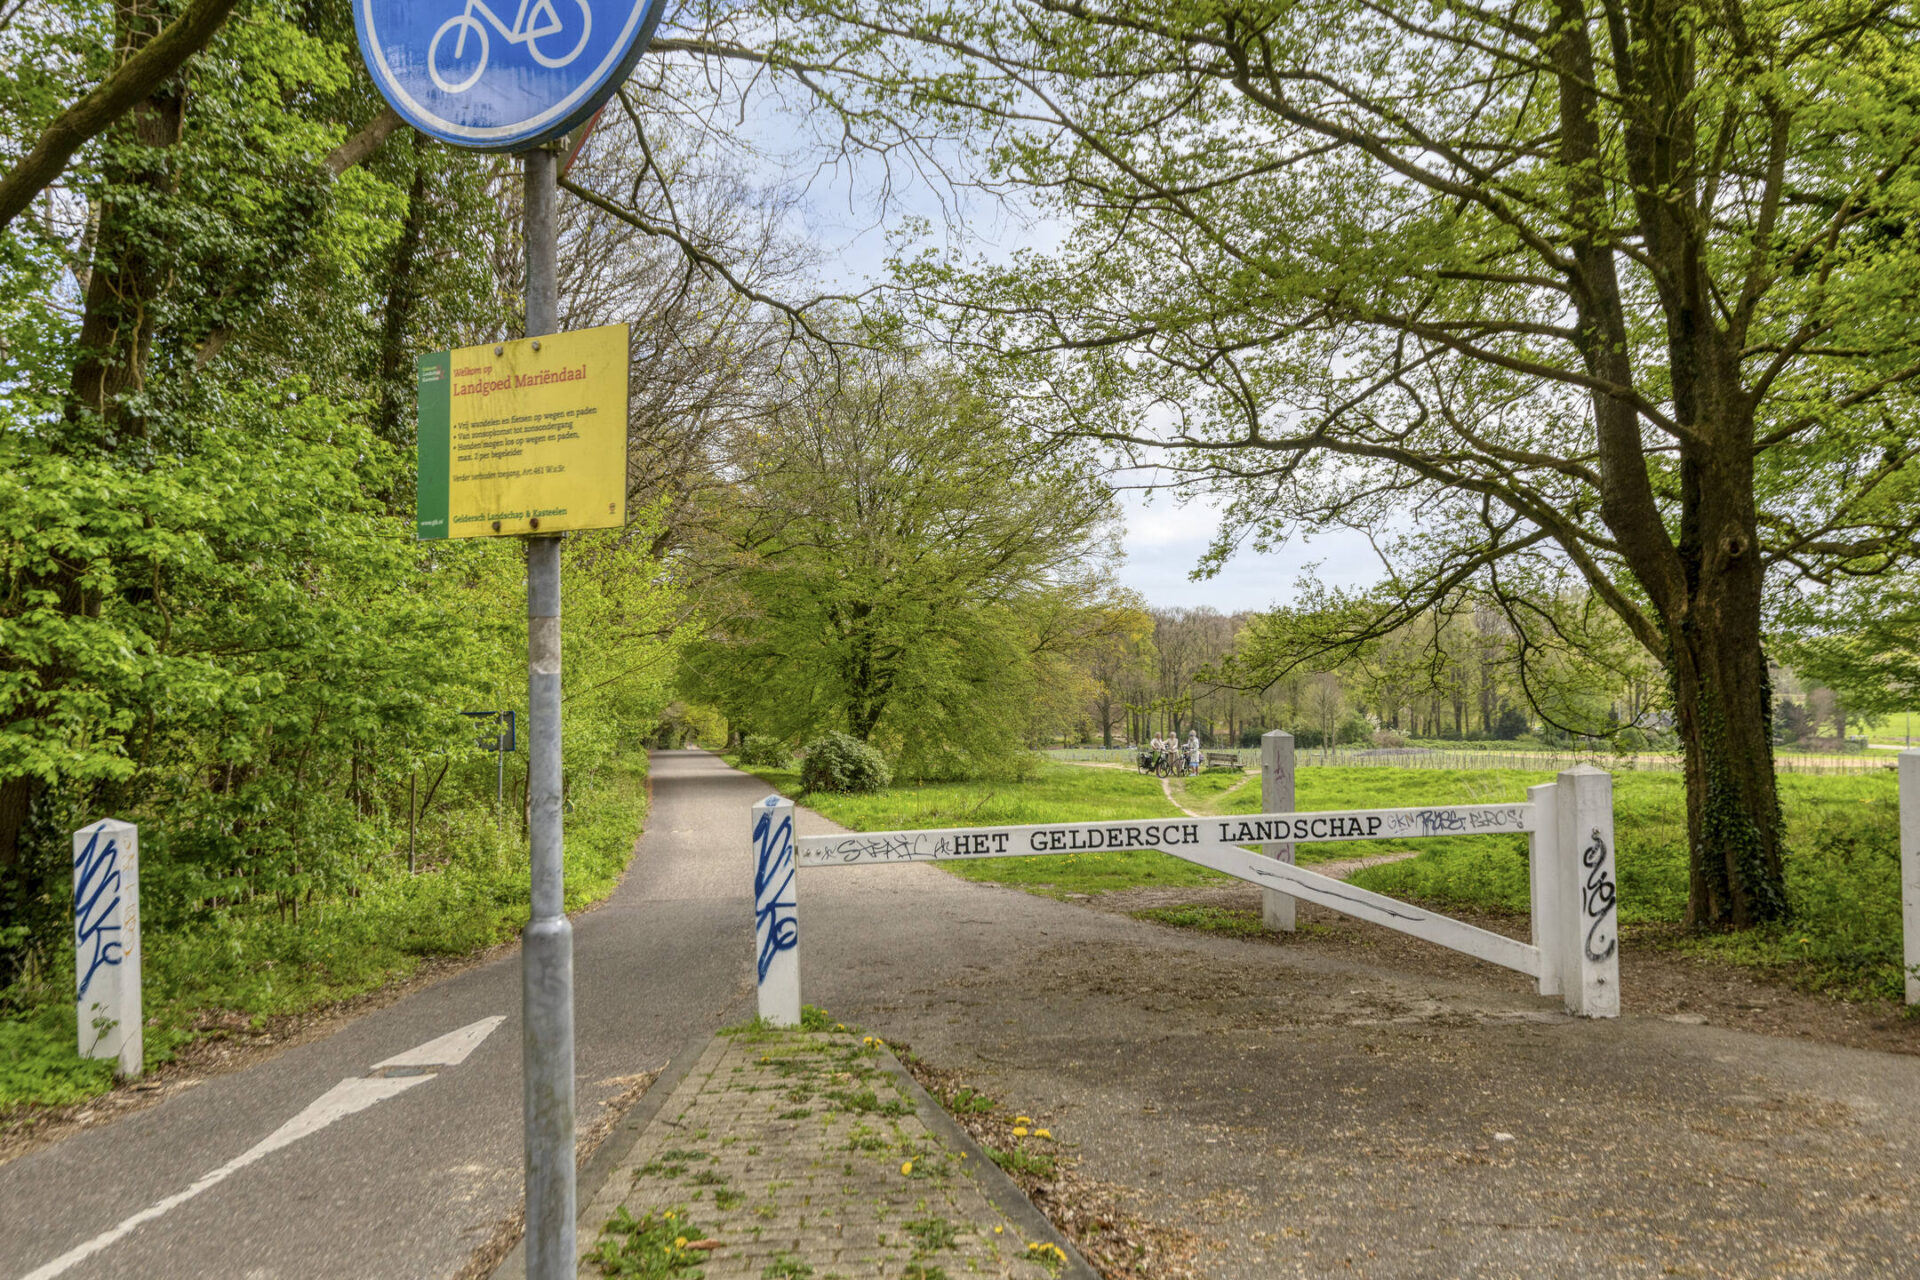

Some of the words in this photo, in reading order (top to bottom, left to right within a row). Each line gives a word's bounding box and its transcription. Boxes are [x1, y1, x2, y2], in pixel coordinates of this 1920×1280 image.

[454, 368, 482, 378] Welkom
[483, 366, 492, 376] op
[454, 376, 511, 396] Landgoed
[515, 364, 586, 388] Mariëndaal
[534, 414, 542, 422] op
[544, 411, 564, 421] wegen
[576, 406, 597, 418] paden
[482, 439, 504, 449] mogen
[516, 438, 524, 446] op
[526, 434, 546, 444] wegen
[488, 510, 523, 521] Landschap
[953, 831, 1010, 856] HET
[1029, 823, 1198, 852] GELDERSCH
[1218, 814, 1384, 844] LANDSCHAP
